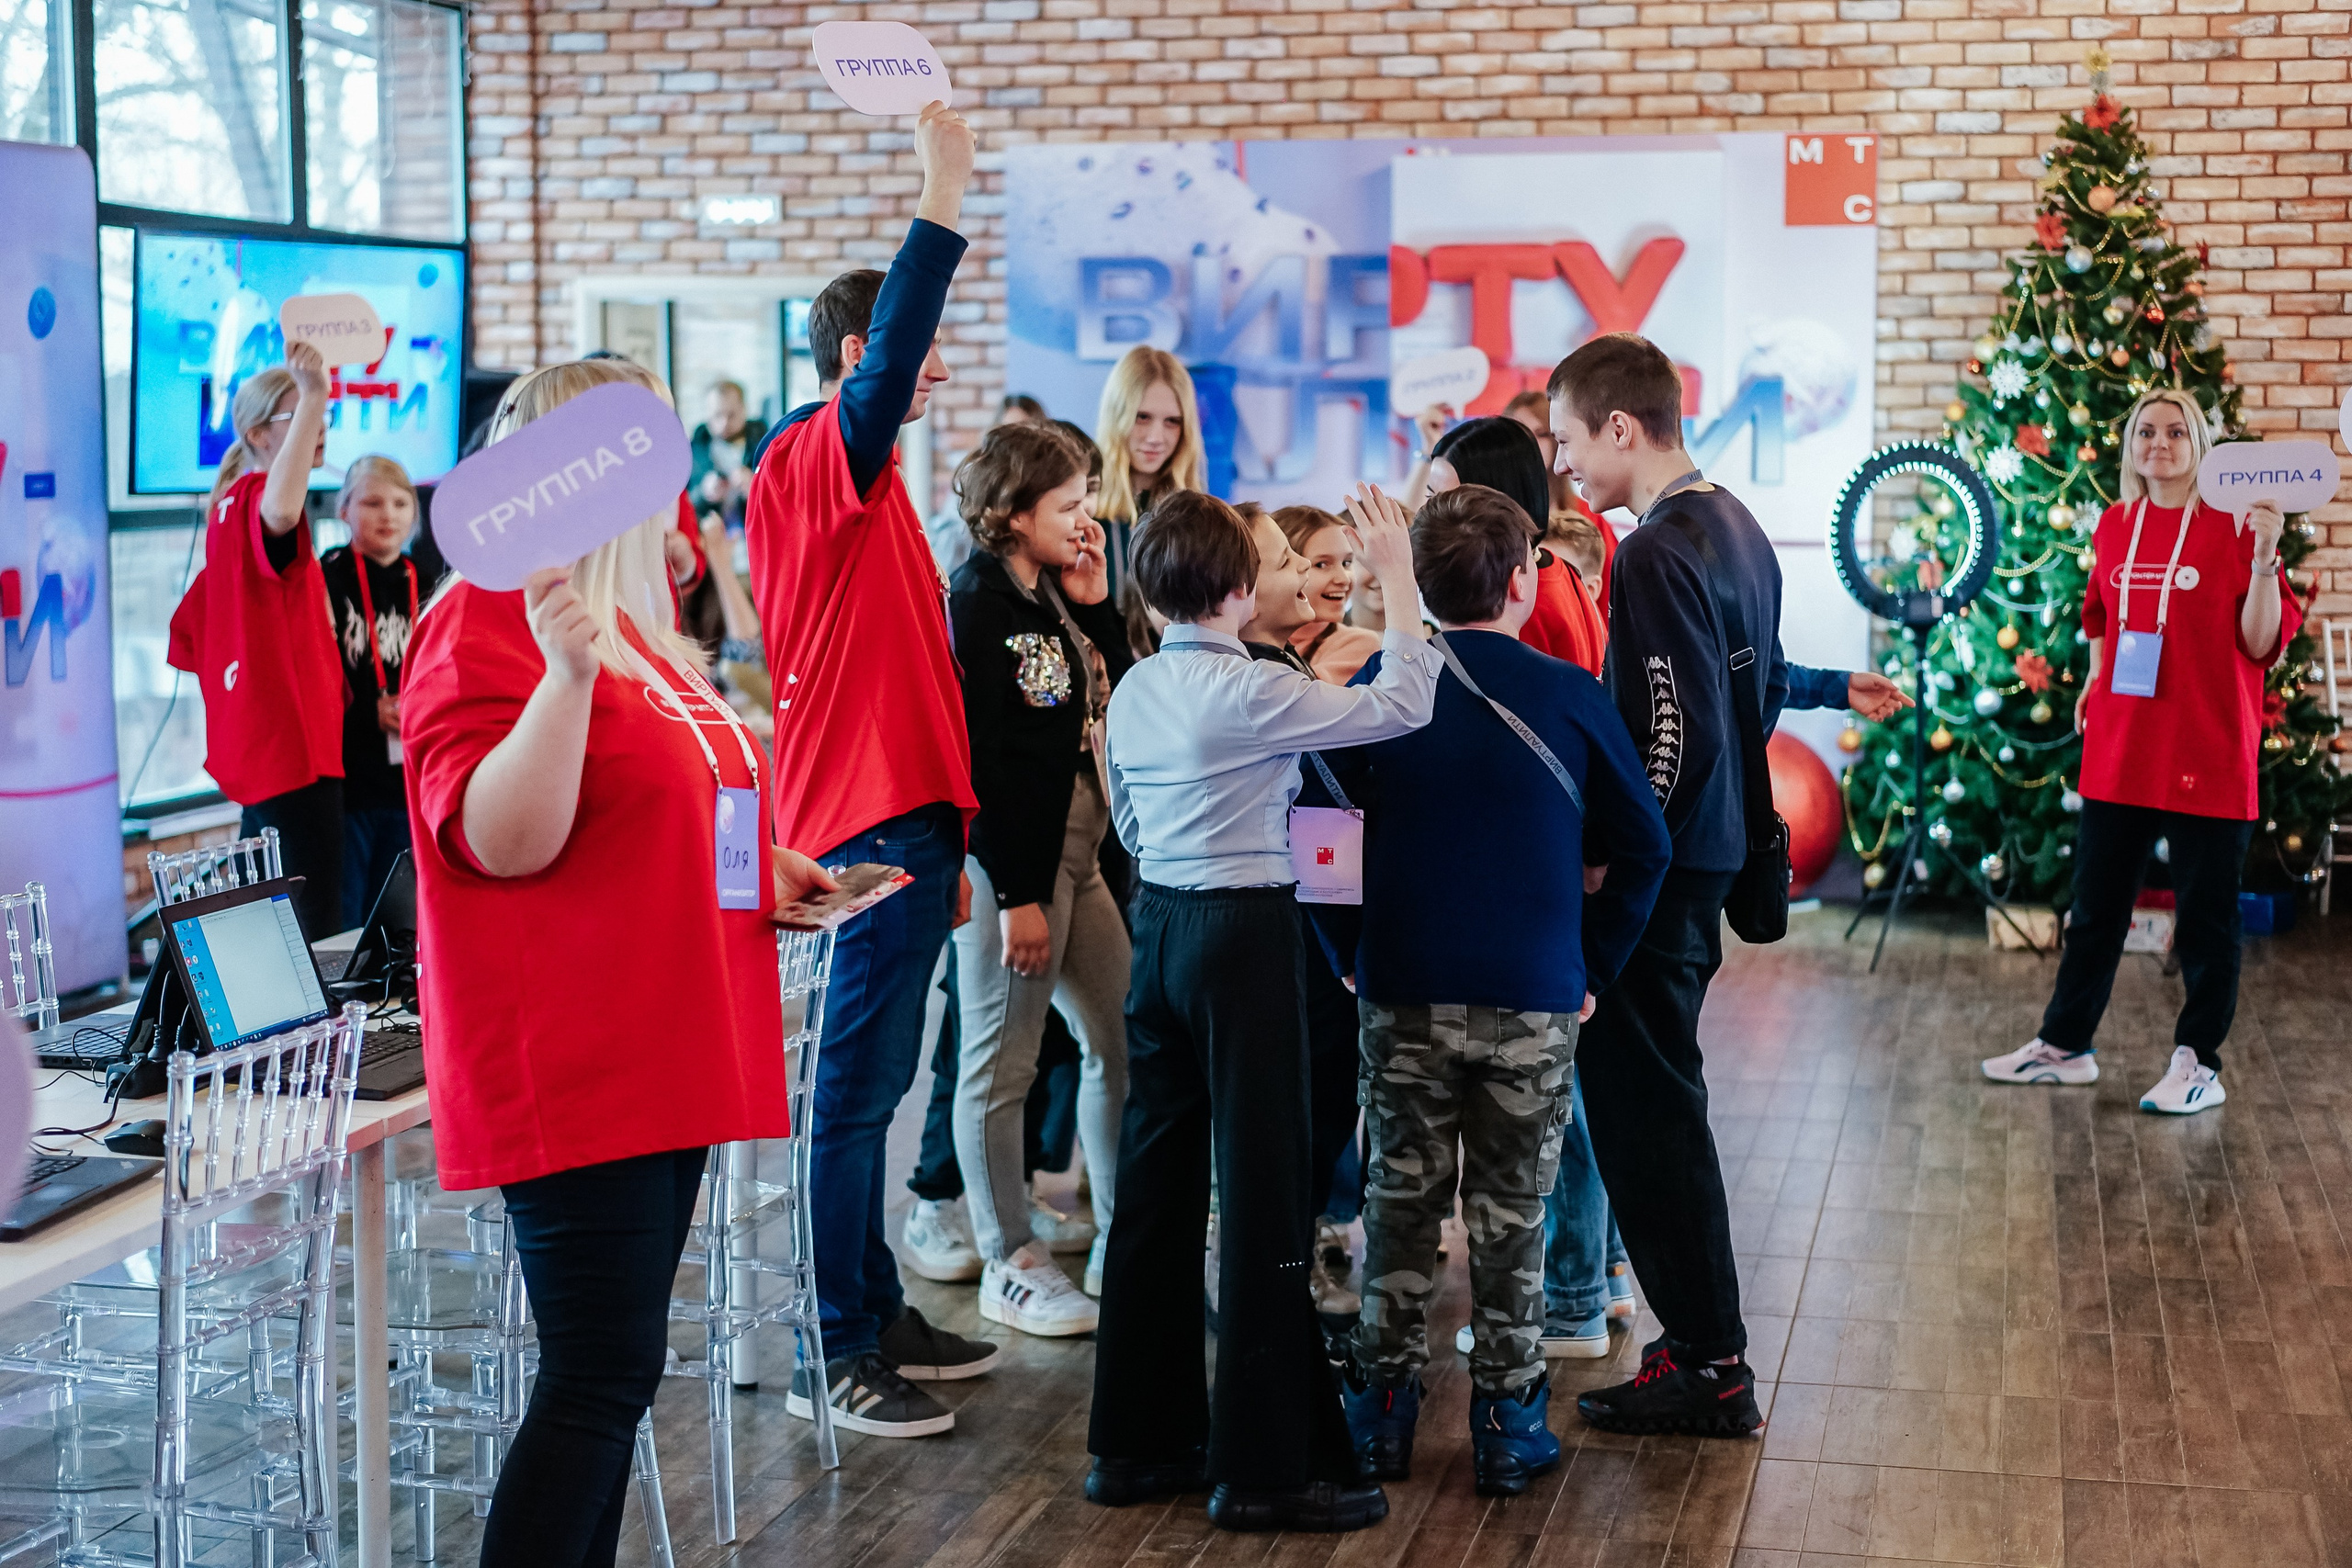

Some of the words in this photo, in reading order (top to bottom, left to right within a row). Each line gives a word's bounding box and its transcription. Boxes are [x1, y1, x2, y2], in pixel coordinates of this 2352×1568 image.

[835, 58, 918, 77] ГРУППА
[916, 58, 933, 76] 6
[468, 446, 625, 547] ГРУППА
[622, 426, 653, 457] 8
[2219, 469, 2304, 486] ГРУППА
[2309, 468, 2323, 482] 4
[1507, 714, 1563, 775] ВИРТУАЛИТИ
[1311, 750, 1344, 800] РТУАЛИТИ
